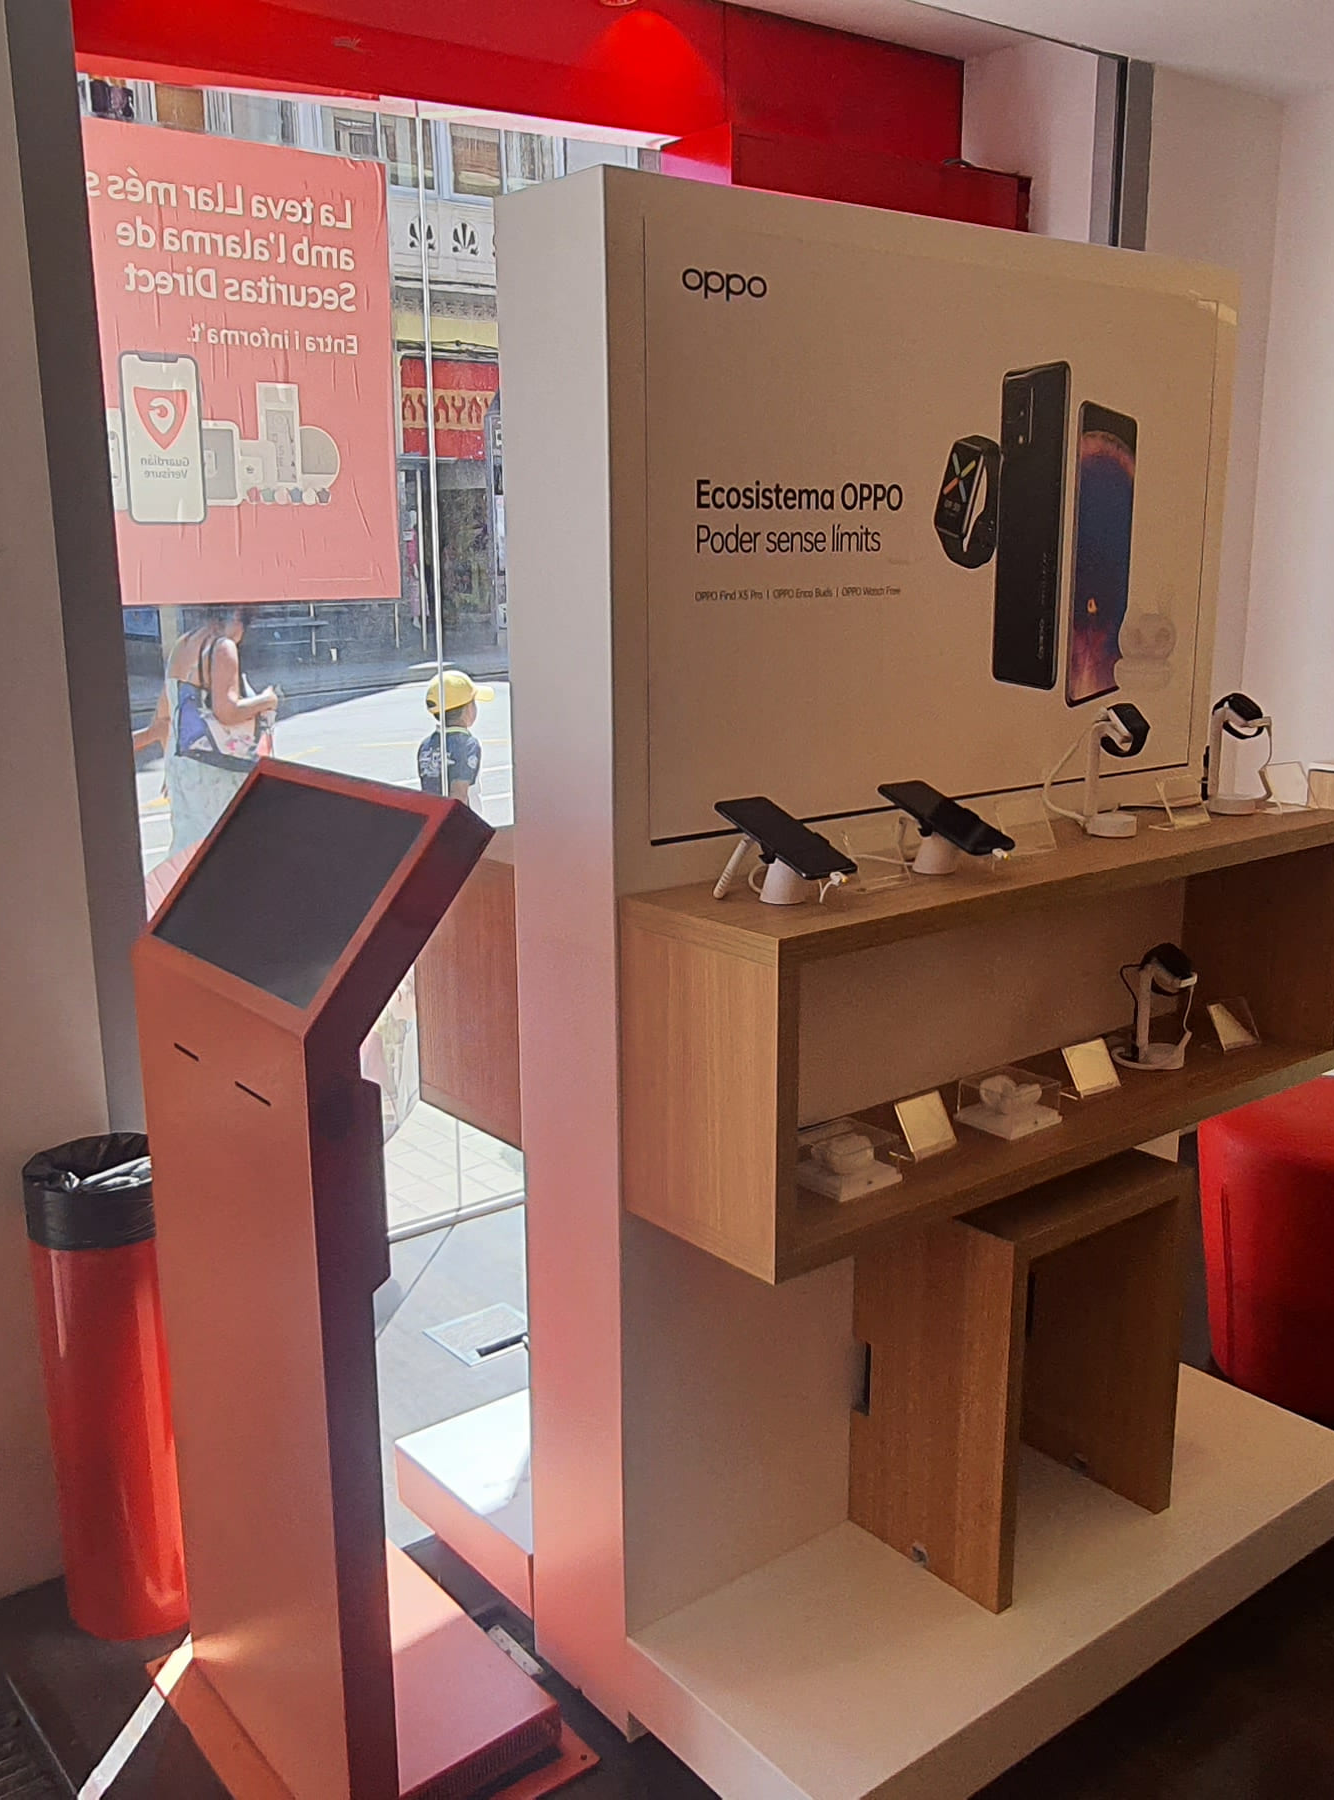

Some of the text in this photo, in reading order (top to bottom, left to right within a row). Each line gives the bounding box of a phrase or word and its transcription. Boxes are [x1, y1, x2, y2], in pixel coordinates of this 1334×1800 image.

[695, 479, 904, 512] Ecosistema OPPO
[696, 523, 882, 554] Poder sense límits
[695, 590, 764, 602] OPPO Find X5 Pro
[773, 589, 795, 600] OPPO
[815, 587, 834, 599] Buds
[842, 587, 862, 598] OPPO
